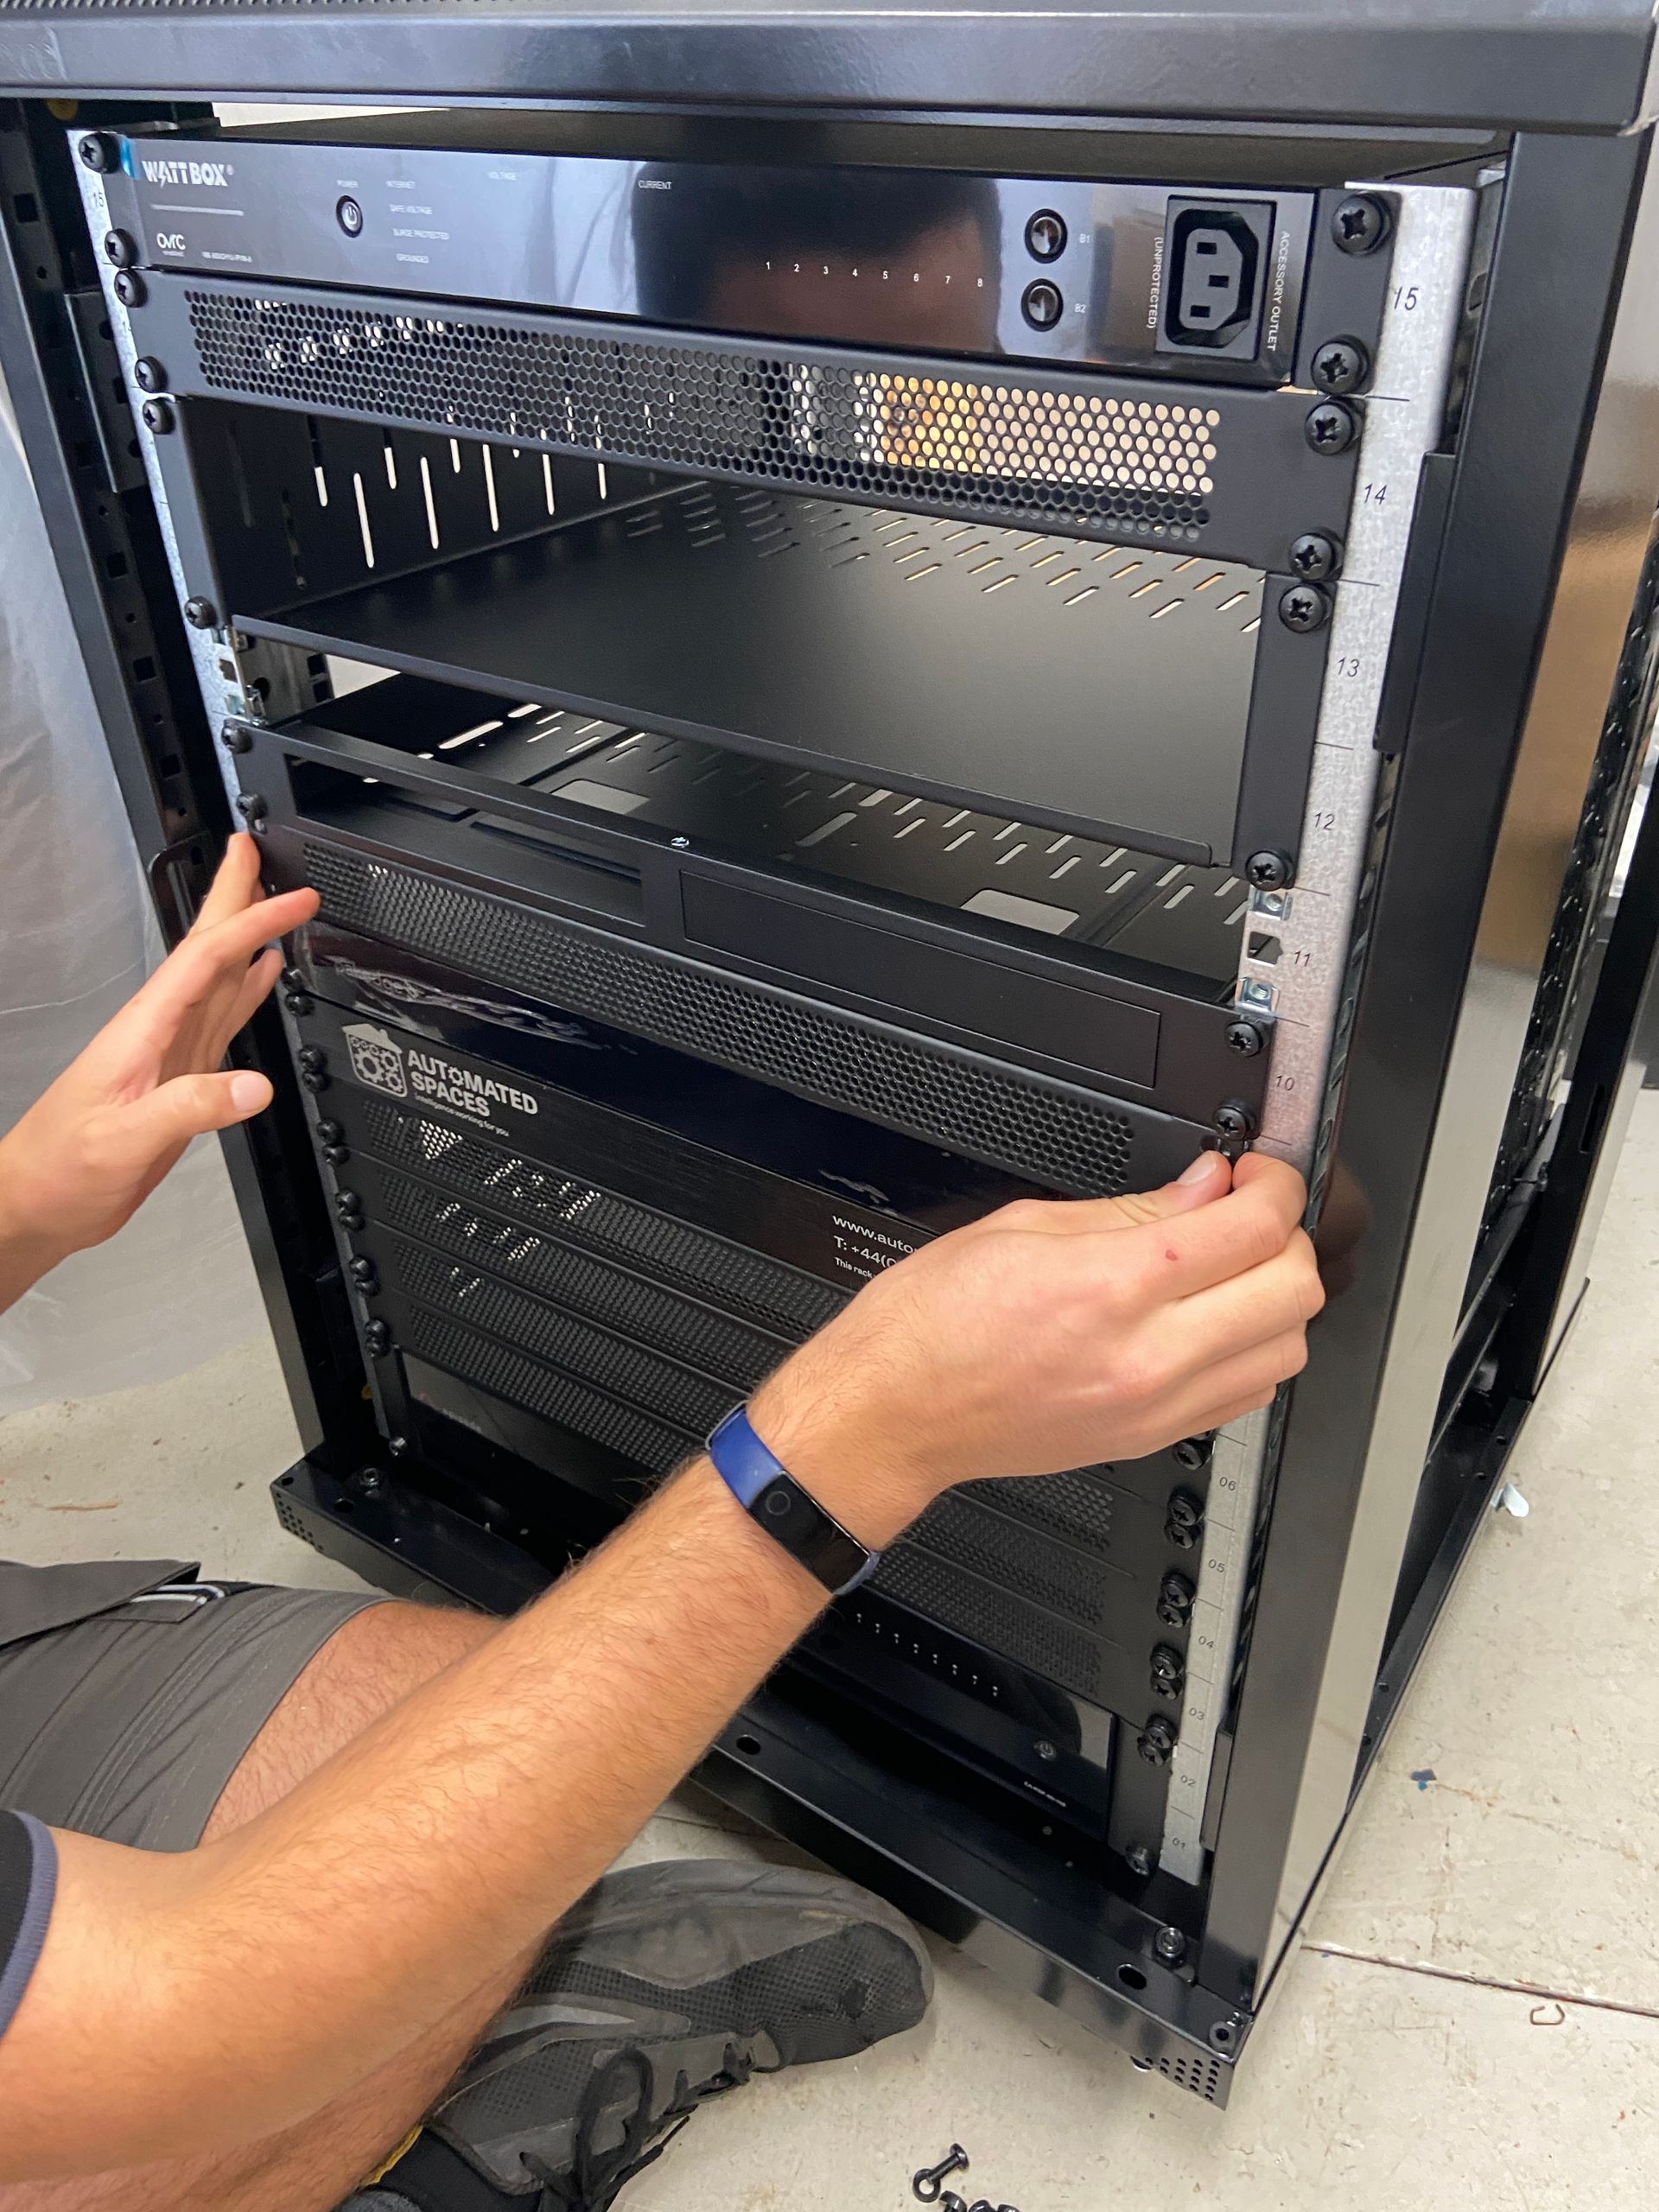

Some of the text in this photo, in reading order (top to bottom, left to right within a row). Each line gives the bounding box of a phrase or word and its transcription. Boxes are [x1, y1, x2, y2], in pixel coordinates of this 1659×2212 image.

[639, 180, 672, 189] CURRENT
[1079, 233, 1090, 243] B1
[794, 264, 799, 272] 2
[823, 266, 829, 275] 3
[852, 269, 858, 277] 4
[882, 270, 888, 280] 5
[913, 273, 919, 282] 6
[945, 276, 950, 284] 7
[977, 278, 983, 287] 8
[1146, 236, 1164, 329] (UNPROTECTED)
[1267, 231, 1290, 352] ACCESSORY OUTLET
[1393, 286, 1419, 311] 15
[1075, 303, 1085, 313] B2
[1363, 484, 1387, 505] 14
[1336, 658, 1360, 678] 13
[1313, 812, 1335, 830] 12
[1294, 950, 1311, 968] 11
[408, 1049, 538, 1115] AUTOMATED
[1275, 1075, 1295, 1092] 10
[411, 1071, 491, 1117] SPACES
[832, 1215, 917, 1254] www.auto
[834, 1235, 848, 1251] T:
[835, 1256, 873, 1278] This rack
[1219, 1476, 1236, 1491] 06
[1208, 1558, 1225, 1573] 05
[1198, 1635, 1215, 1650] 04
[1189, 1707, 1205, 1721] 03
[1180, 1774, 1196, 1788] 02
[1172, 1837, 1186, 1850] 01
